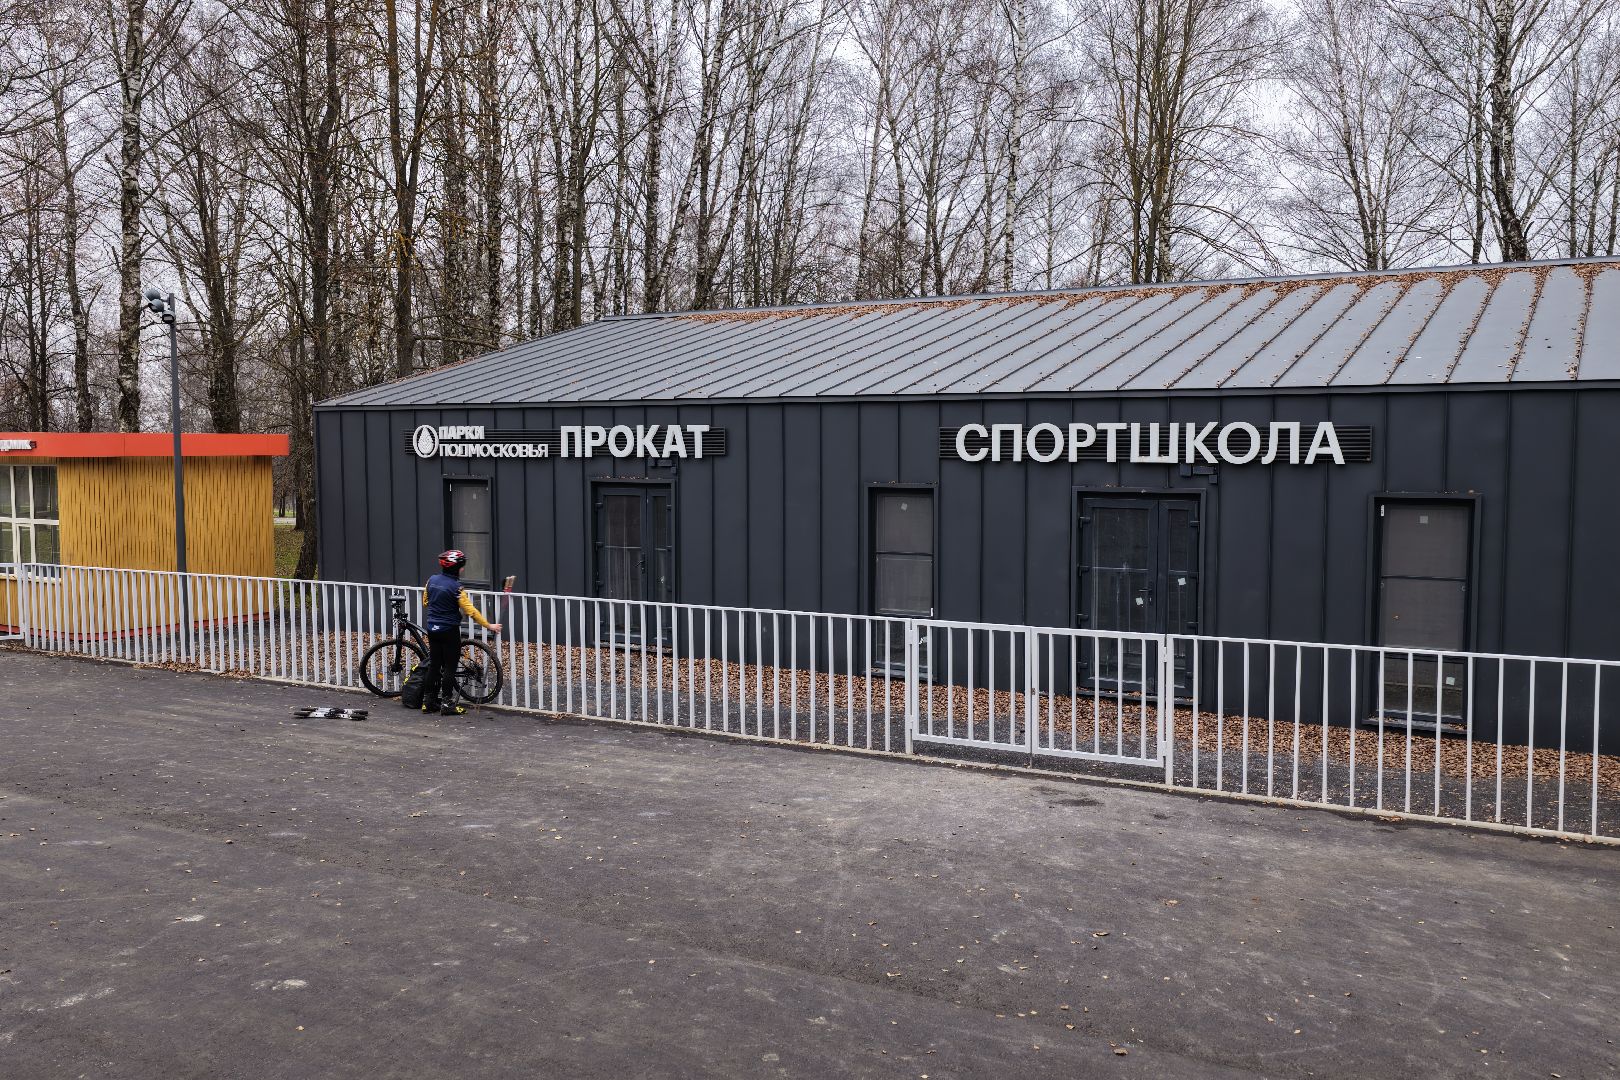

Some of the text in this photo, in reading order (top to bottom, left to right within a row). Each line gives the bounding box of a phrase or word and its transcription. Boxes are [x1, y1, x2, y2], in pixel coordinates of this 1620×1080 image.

[438, 426, 485, 440] ПАРКИ
[560, 425, 710, 459] ПРОКАТ
[955, 421, 1346, 465] СПОРТШКОЛА
[439, 443, 549, 458] ПОДМОСКОВЬЯ
